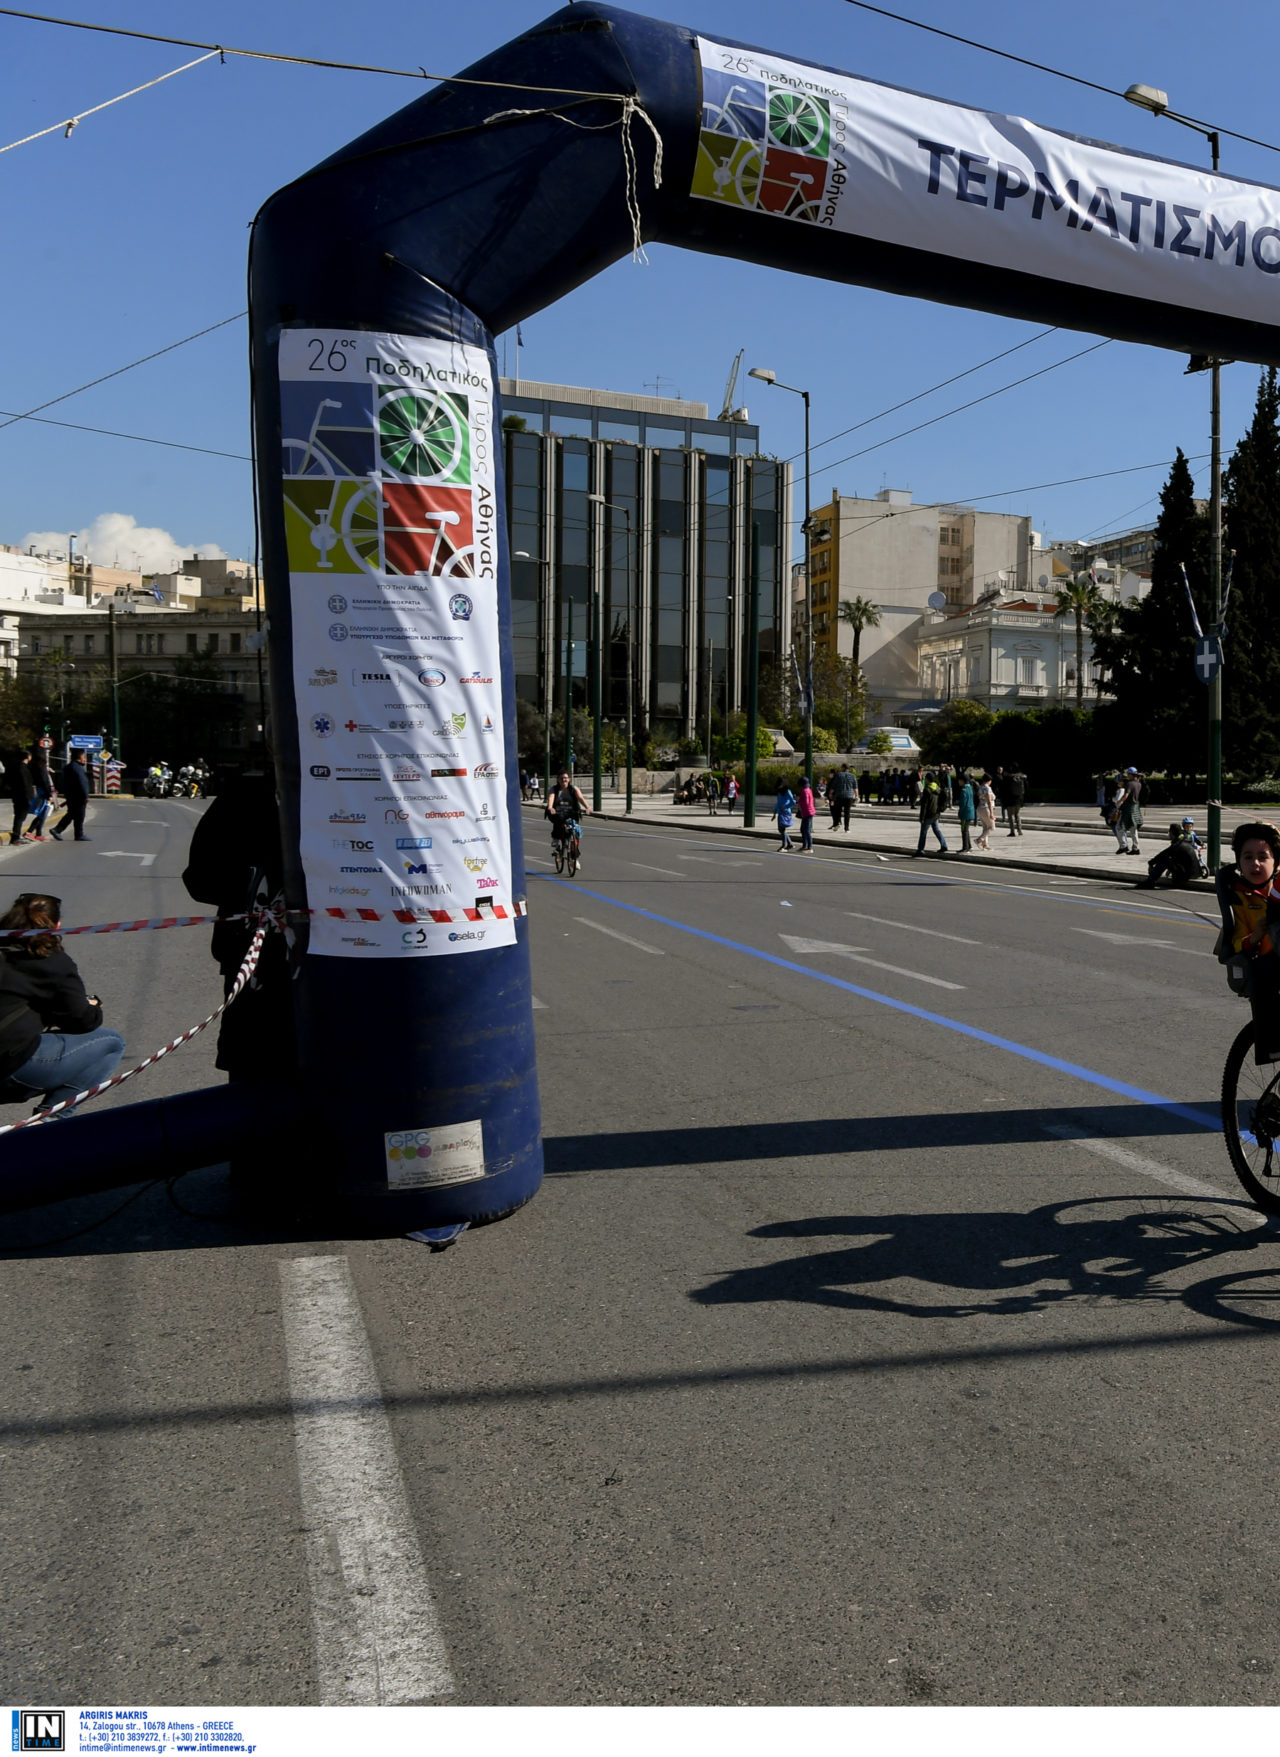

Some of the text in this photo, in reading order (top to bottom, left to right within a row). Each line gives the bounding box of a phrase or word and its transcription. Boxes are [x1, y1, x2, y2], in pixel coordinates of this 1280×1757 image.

[760, 69, 848, 101] Ποδηλατικός
[819, 158, 848, 226] Αθήνας
[366, 356, 488, 392] Ποδηλατικός
[473, 398, 488, 475] Γύρος
[476, 484, 494, 580] Αθήνας
[390, 883, 453, 897] INFOWOMAN
